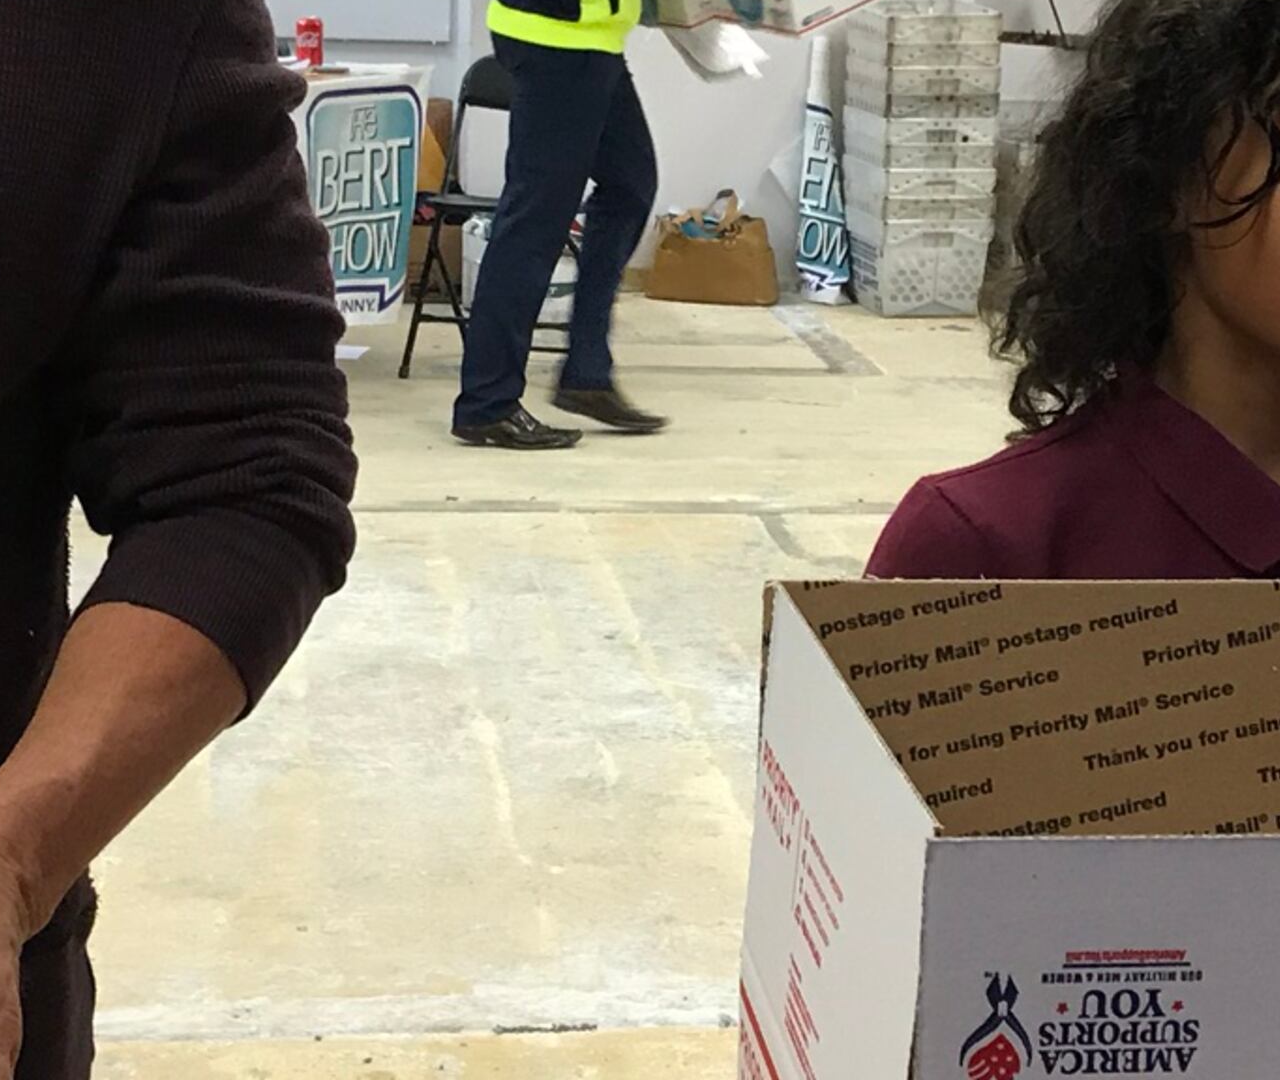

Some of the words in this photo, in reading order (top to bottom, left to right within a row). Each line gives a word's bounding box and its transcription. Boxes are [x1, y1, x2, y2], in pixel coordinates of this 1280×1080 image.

[316, 137, 412, 217] BERT
[331, 212, 399, 272] HOW
[819, 608, 905, 639] postage
[912, 584, 1003, 618] required
[850, 651, 929, 681] Priority
[997, 622, 1082, 654] postage
[1089, 599, 1179, 632] required
[1143, 638, 1222, 666] Priority
[979, 670, 1059, 697] Service
[909, 742, 941, 762] for
[946, 731, 1004, 756] using
[1009, 712, 1089, 741] Priority
[1155, 683, 1234, 710] Service
[1083, 745, 1149, 771] Thank
[1154, 736, 1193, 760] you
[1198, 729, 1231, 747] for
[925, 778, 994, 808] quired
[1078, 791, 1167, 824] required
[1041, 973, 1082, 984] WOMEN
[1097, 972, 1119, 983] MEN
[1124, 971, 1177, 983] MILITARY
[1181, 970, 1203, 982] OUR
[1078, 989, 1166, 1019] YOU
[1038, 1019, 1200, 1047] SUPPORTS
[1038, 1047, 1197, 1075] AMERICA
